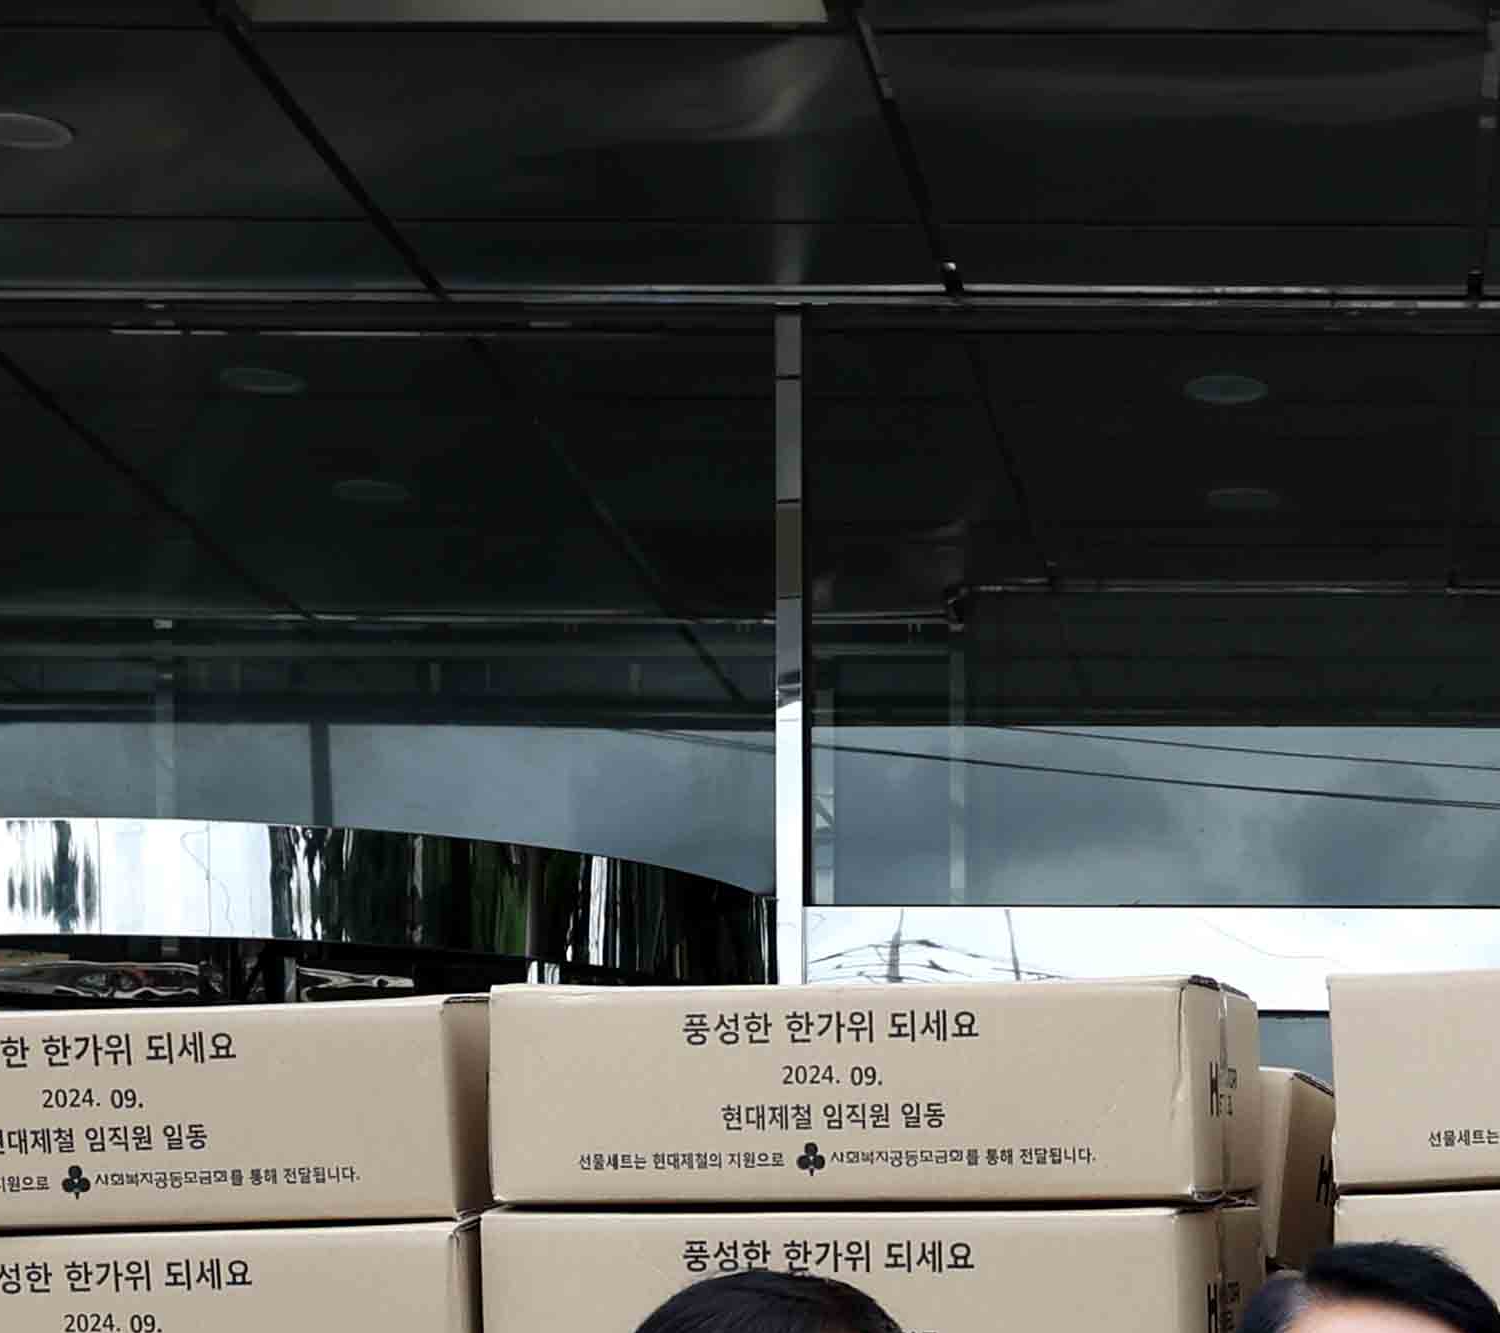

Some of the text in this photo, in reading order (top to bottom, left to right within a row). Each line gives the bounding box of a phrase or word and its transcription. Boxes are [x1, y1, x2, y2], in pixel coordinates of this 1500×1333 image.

[41, 1032, 133, 1068] 한가위
[145, 1030, 237, 1065] 되세요
[41, 1087, 144, 1110] 2024. 09.
[84, 1124, 154, 1153] 임직원
[161, 1122, 208, 1151] 일동
[1427, 1128, 1500, 1148] 선물세트는
[248, 1167, 278, 1187] 통해
[282, 1165, 361, 1185] 전달됩니다.
